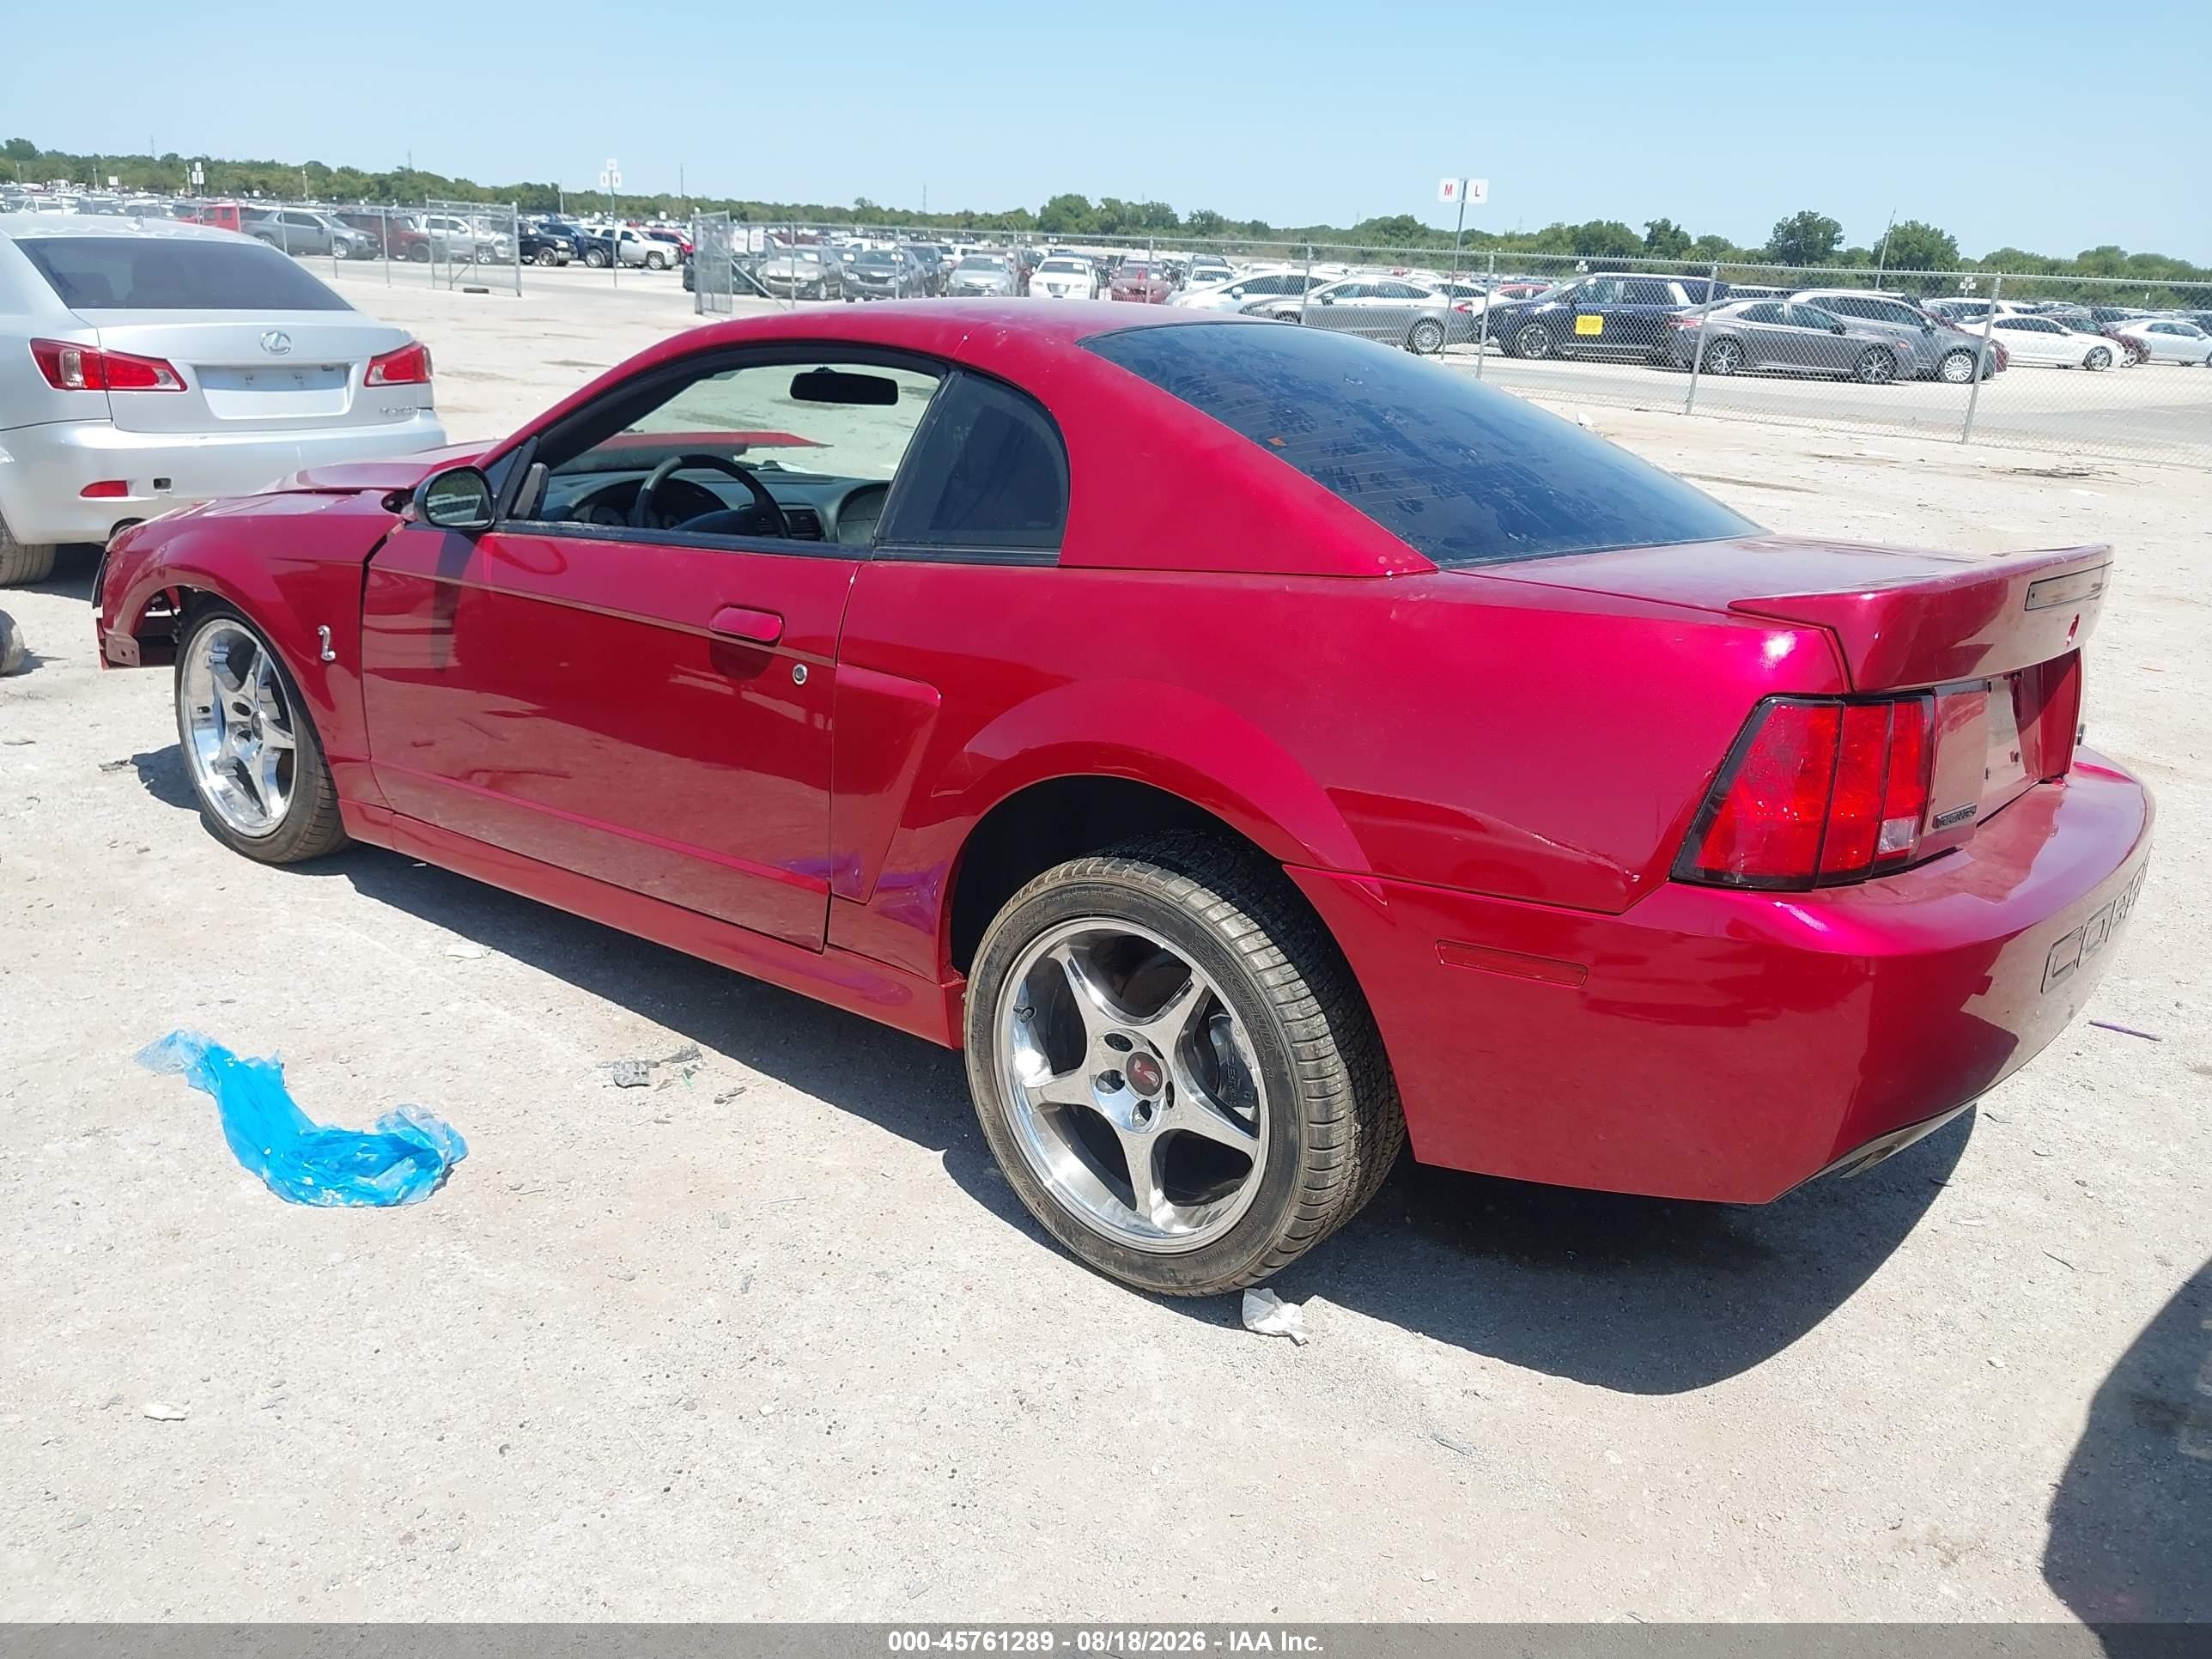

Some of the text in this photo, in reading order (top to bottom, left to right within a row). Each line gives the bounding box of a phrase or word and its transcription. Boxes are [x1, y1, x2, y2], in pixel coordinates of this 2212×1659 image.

[1443, 183, 1453, 197] M
[1474, 185, 1480, 198] L
[1212, 957, 1277, 1052] MICHELIN
